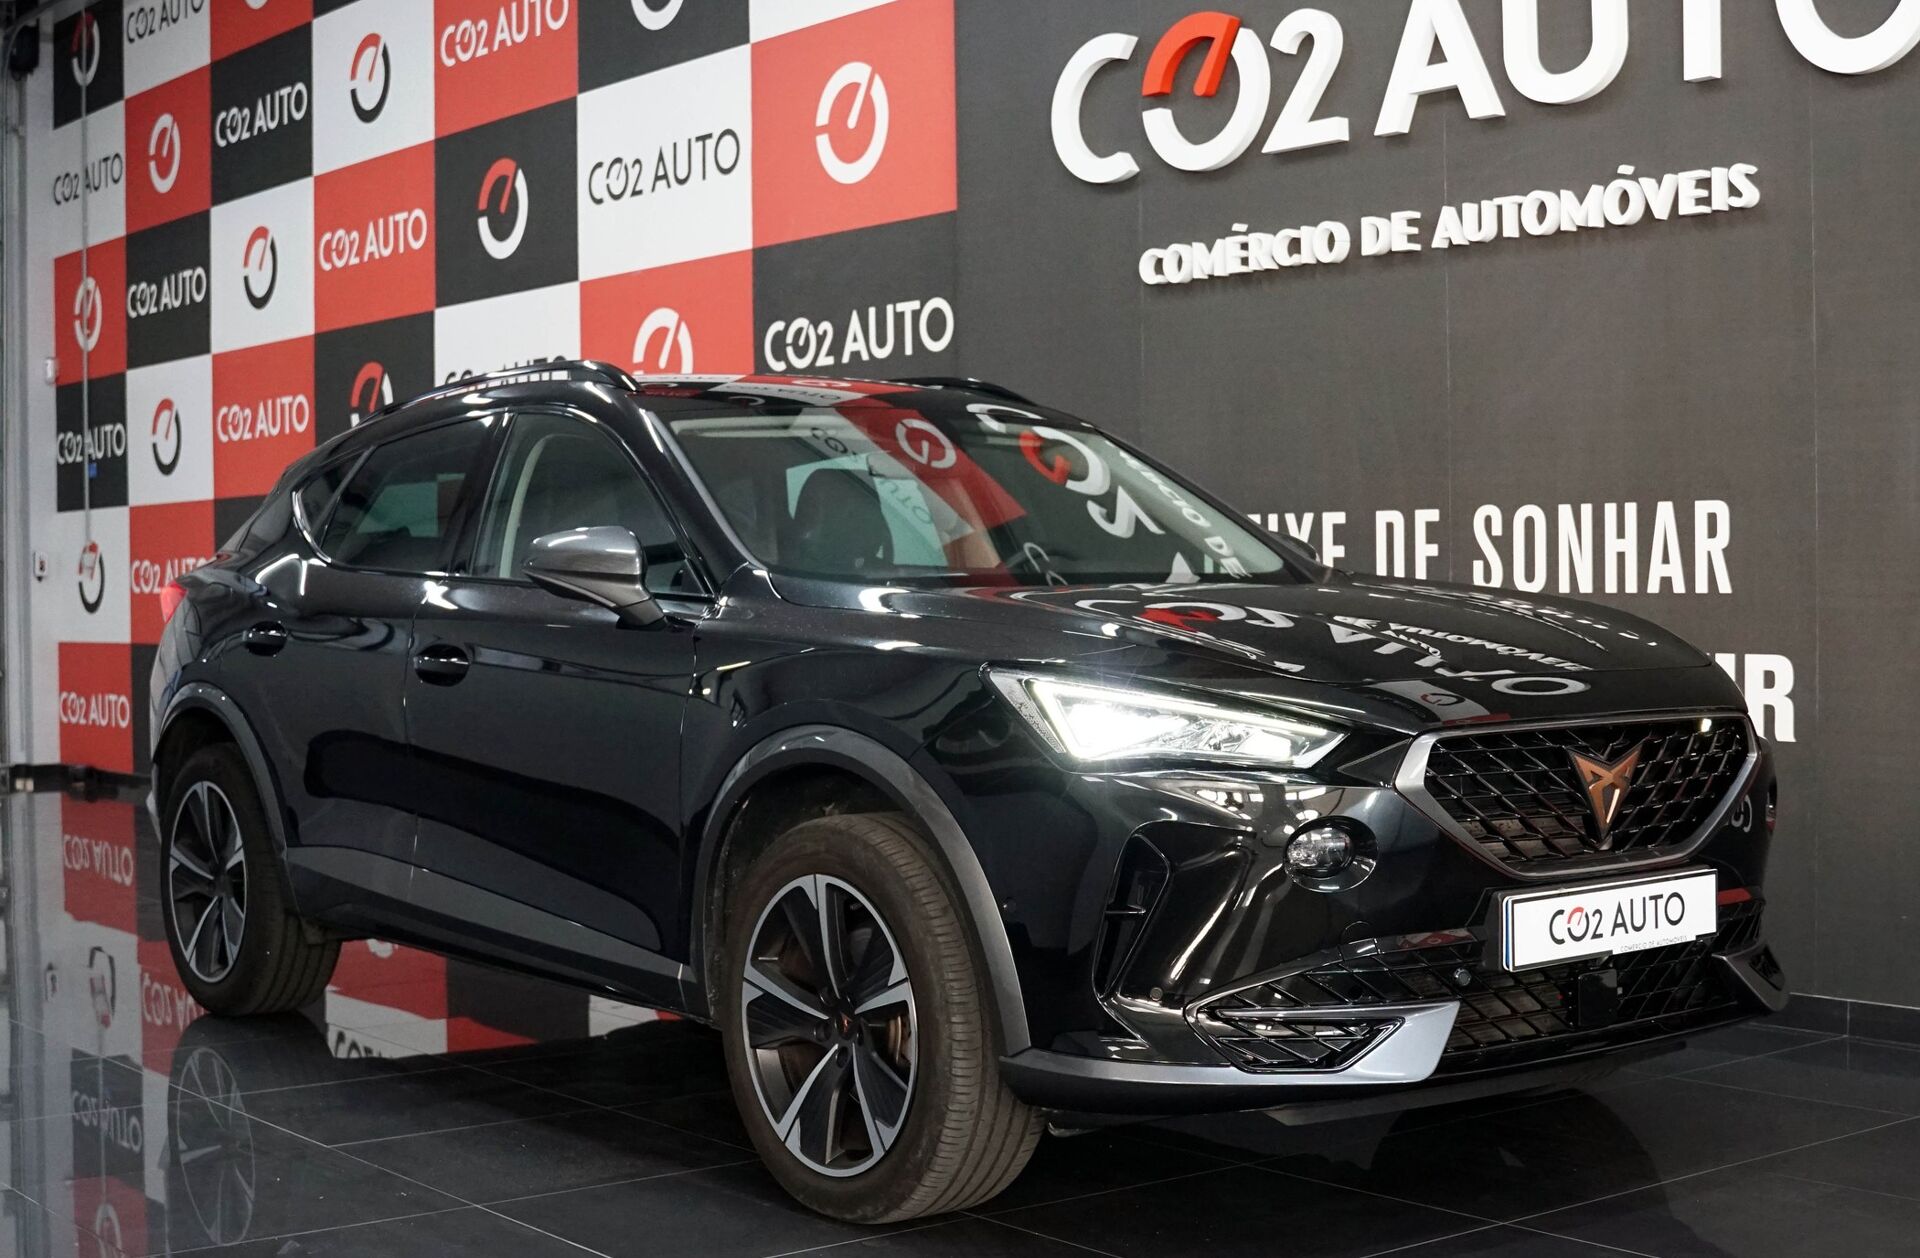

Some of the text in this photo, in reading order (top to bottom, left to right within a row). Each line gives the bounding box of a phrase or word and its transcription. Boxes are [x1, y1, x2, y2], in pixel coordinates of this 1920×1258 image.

[127, 8, 156, 44] CO2
[440, 0, 569, 67] CO2 AUTO
[215, 82, 308, 148] CO2 AUTO
[1051, 8, 1349, 184] CO2
[53, 152, 123, 206] CO2 AUTO
[588, 128, 741, 206] CO2 AUTO
[319, 208, 428, 271] CO2 AUTO
[1139, 163, 1760, 285] COMÉRCIO DE AUTOMÓVEIS
[127, 266, 207, 319] CO2 AUTO
[764, 296, 954, 375] CO2 AUTO
[57, 422, 126, 465] CO2 AUTO
[217, 394, 310, 443] CO2 AUTO
[1472, 499, 1733, 594] SONHAR
[131, 560, 161, 594] CO2
[59, 691, 130, 729] CO2 AUTO
[1549, 891, 1686, 946] CO2 AUTO
